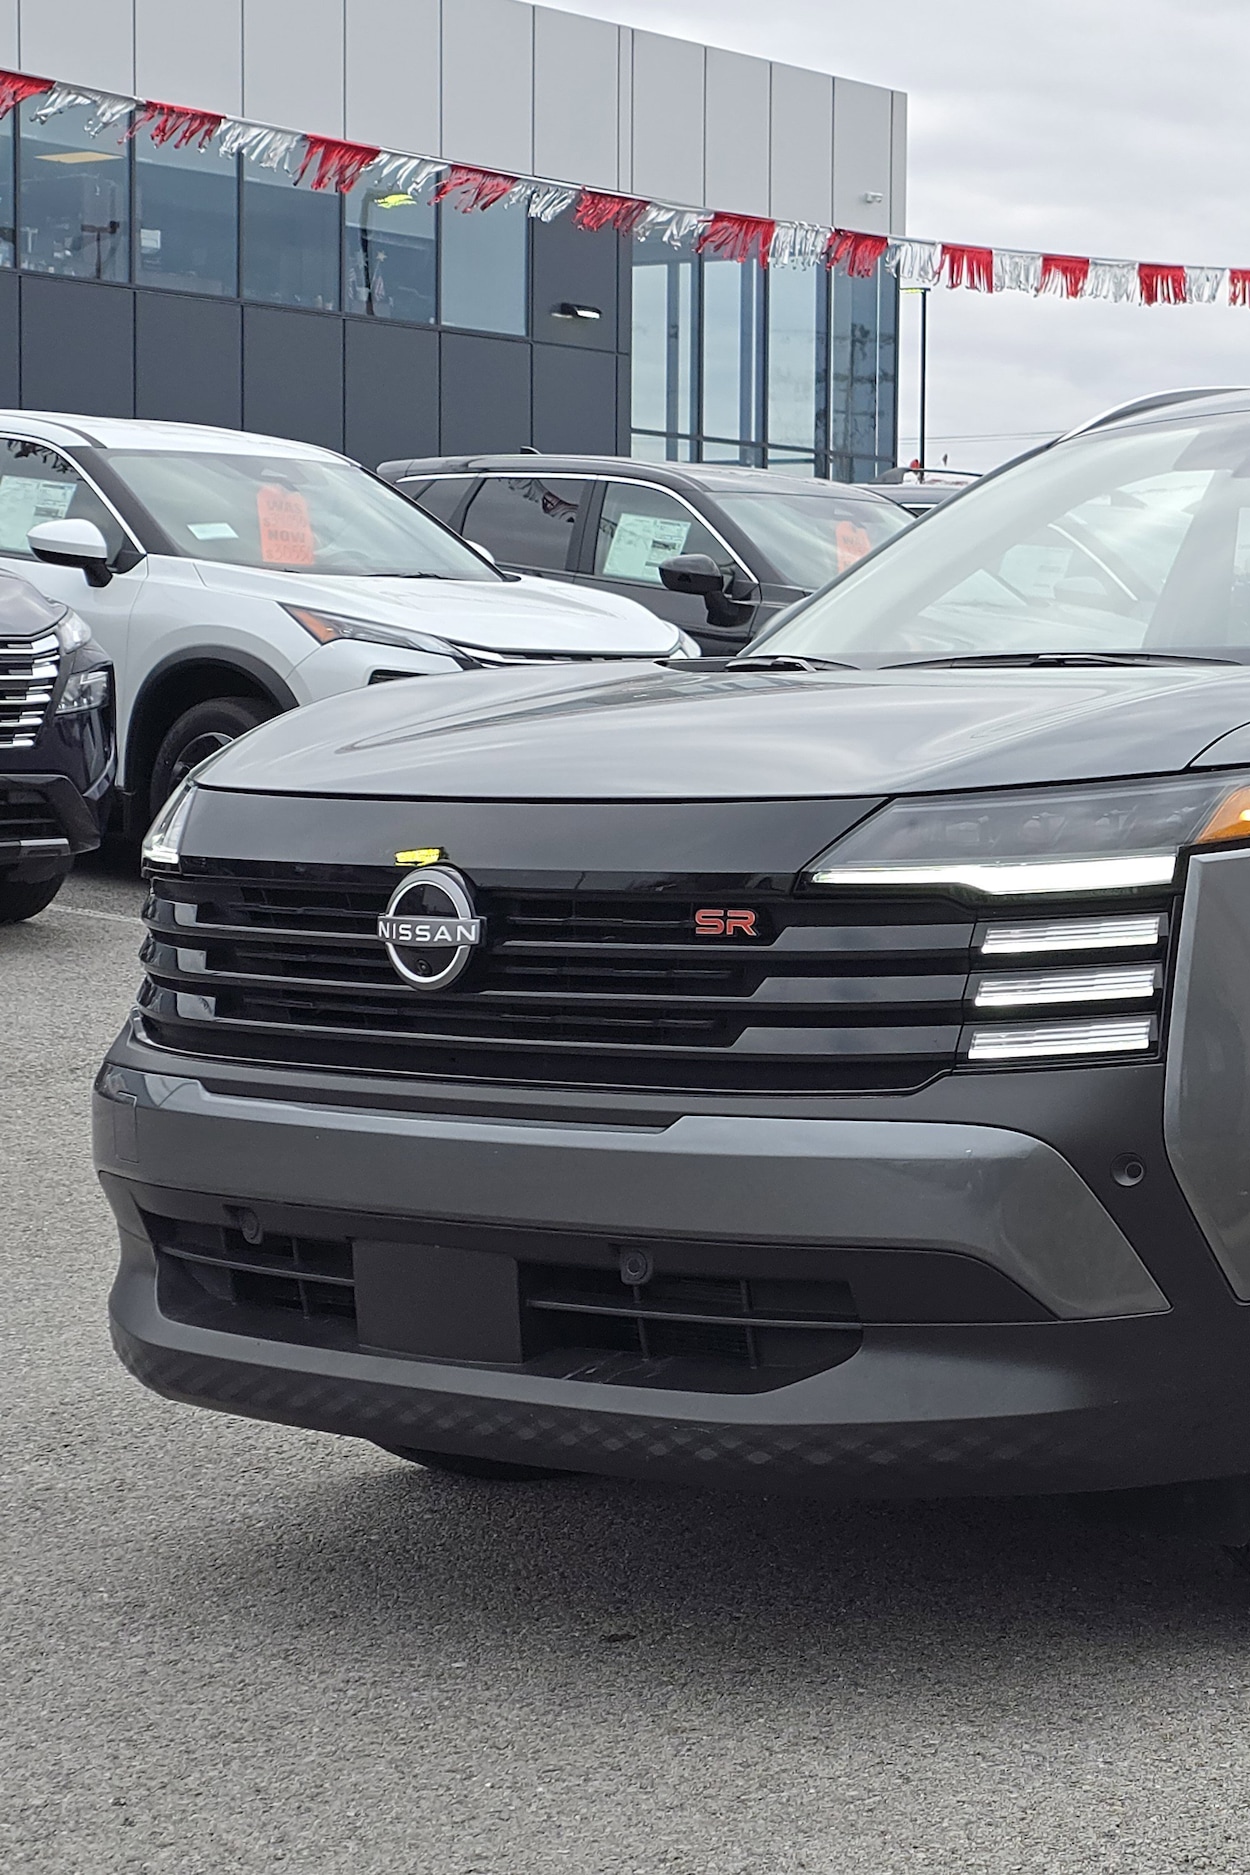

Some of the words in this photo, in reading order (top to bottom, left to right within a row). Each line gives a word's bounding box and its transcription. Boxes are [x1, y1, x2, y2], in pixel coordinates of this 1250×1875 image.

[268, 528, 305, 543] NOW
[378, 920, 476, 942] NISSAN
[695, 908, 757, 936] SR
